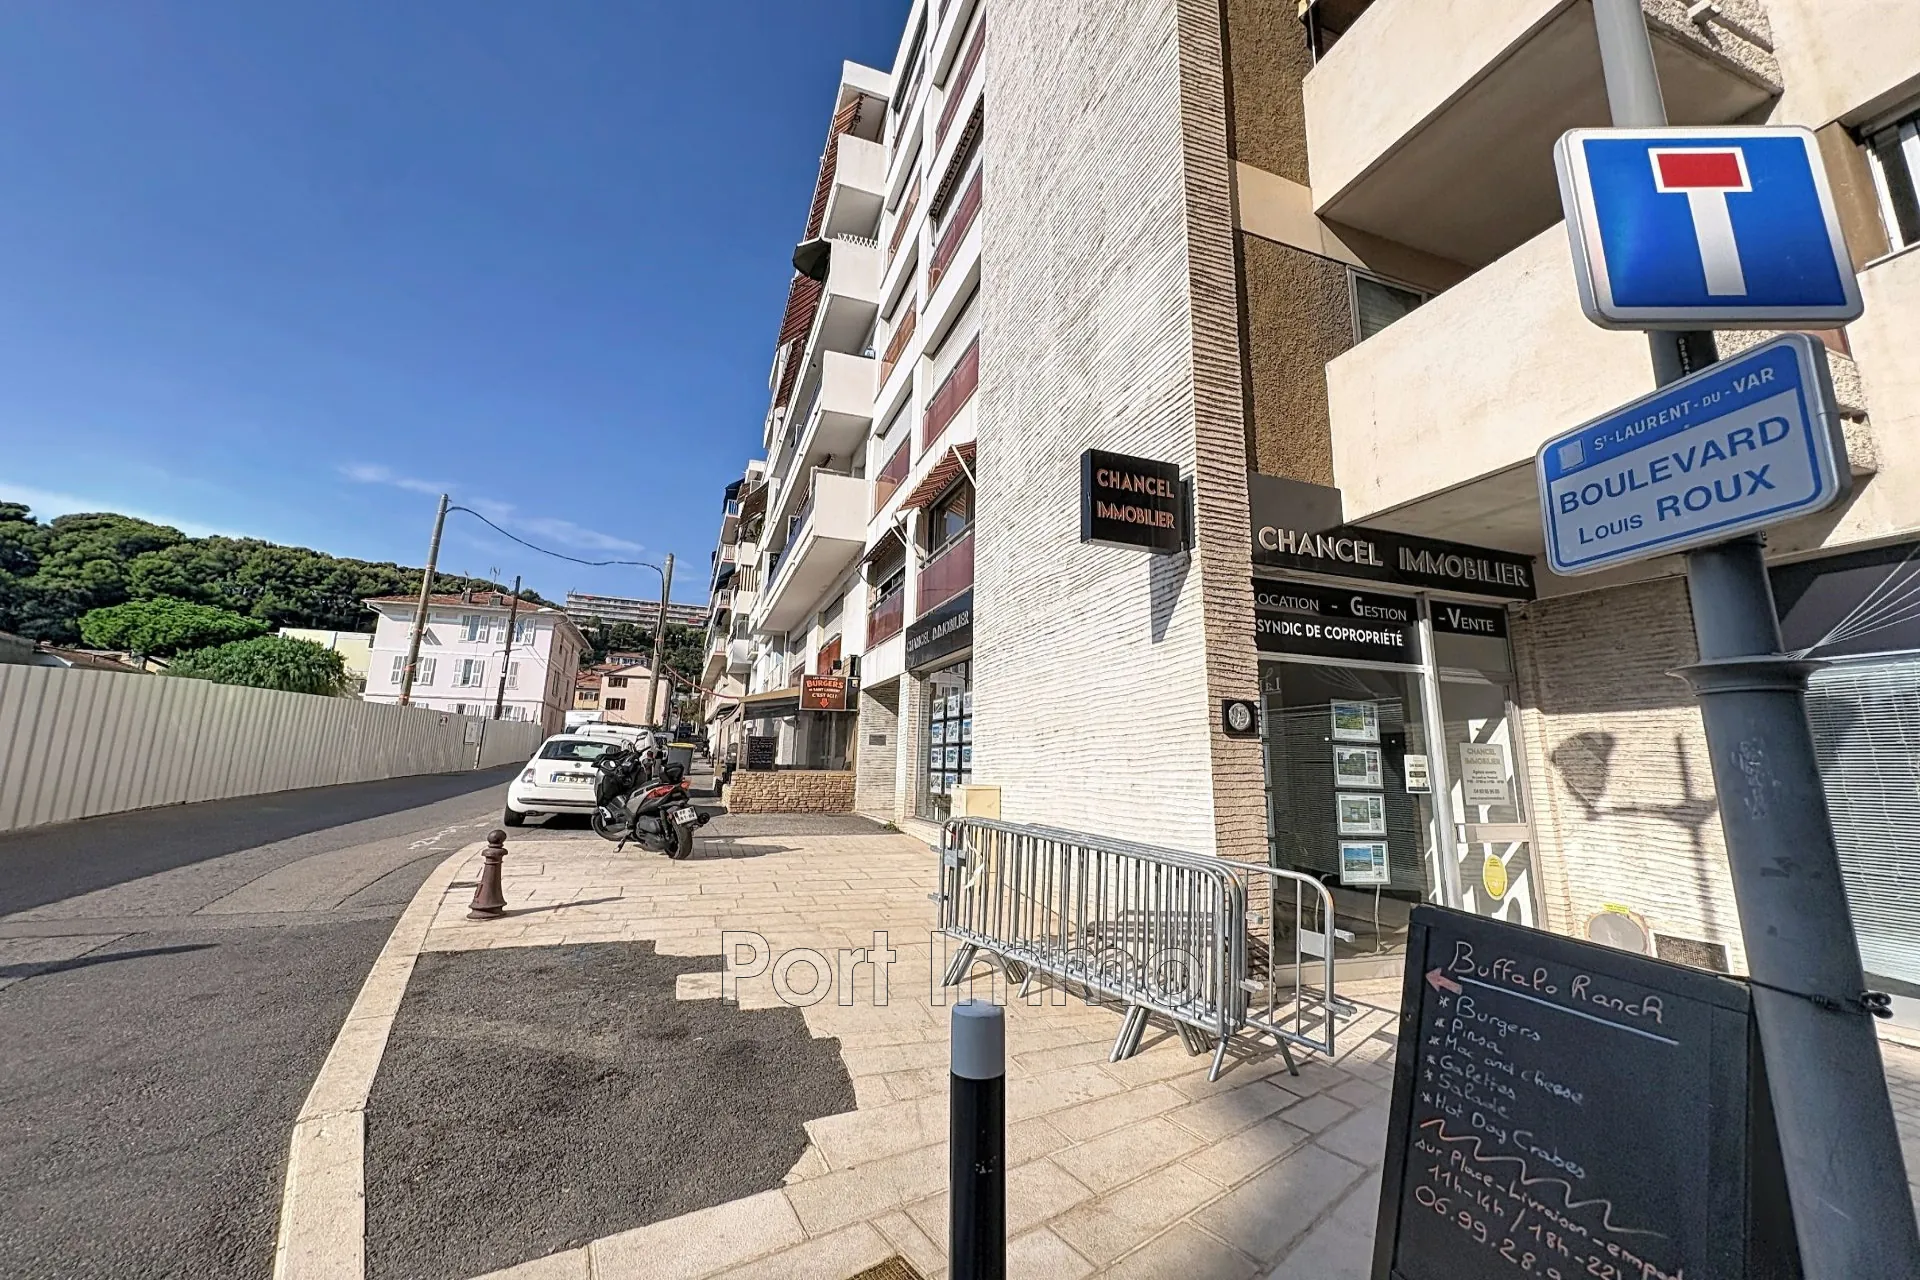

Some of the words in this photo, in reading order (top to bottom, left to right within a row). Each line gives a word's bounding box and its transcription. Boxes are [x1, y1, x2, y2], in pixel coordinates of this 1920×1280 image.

[1096, 468, 1175, 499] CHANCEL
[1559, 415, 1791, 515] BOULEVARD
[1656, 464, 1776, 522] ROUX
[1096, 500, 1175, 529] IMMOBILIER
[1258, 525, 1384, 567] CHANCEL
[1399, 547, 1530, 588] IMMOBILIER
[1254, 593, 1320, 611] OCATION
[1350, 595, 1408, 622] GESTION
[1257, 618, 1303, 637] SYNDIC
[1305, 623, 1321, 639] DE
[1324, 625, 1404, 647] COPROPRIÉTÉ
[806, 679, 844, 689] BURGERS
[1448, 941, 1557, 994] Buffalo
[1451, 1019, 1504, 1055] Pinsa
[1456, 996, 1541, 1042] Burgers
[1444, 1035, 1474, 1060] Mac
[1484, 1056, 1516, 1076] and
[1435, 1092, 1464, 1118] Hot
[1471, 1112, 1508, 1145] Dog
[1513, 1129, 1586, 1180] Crabes
